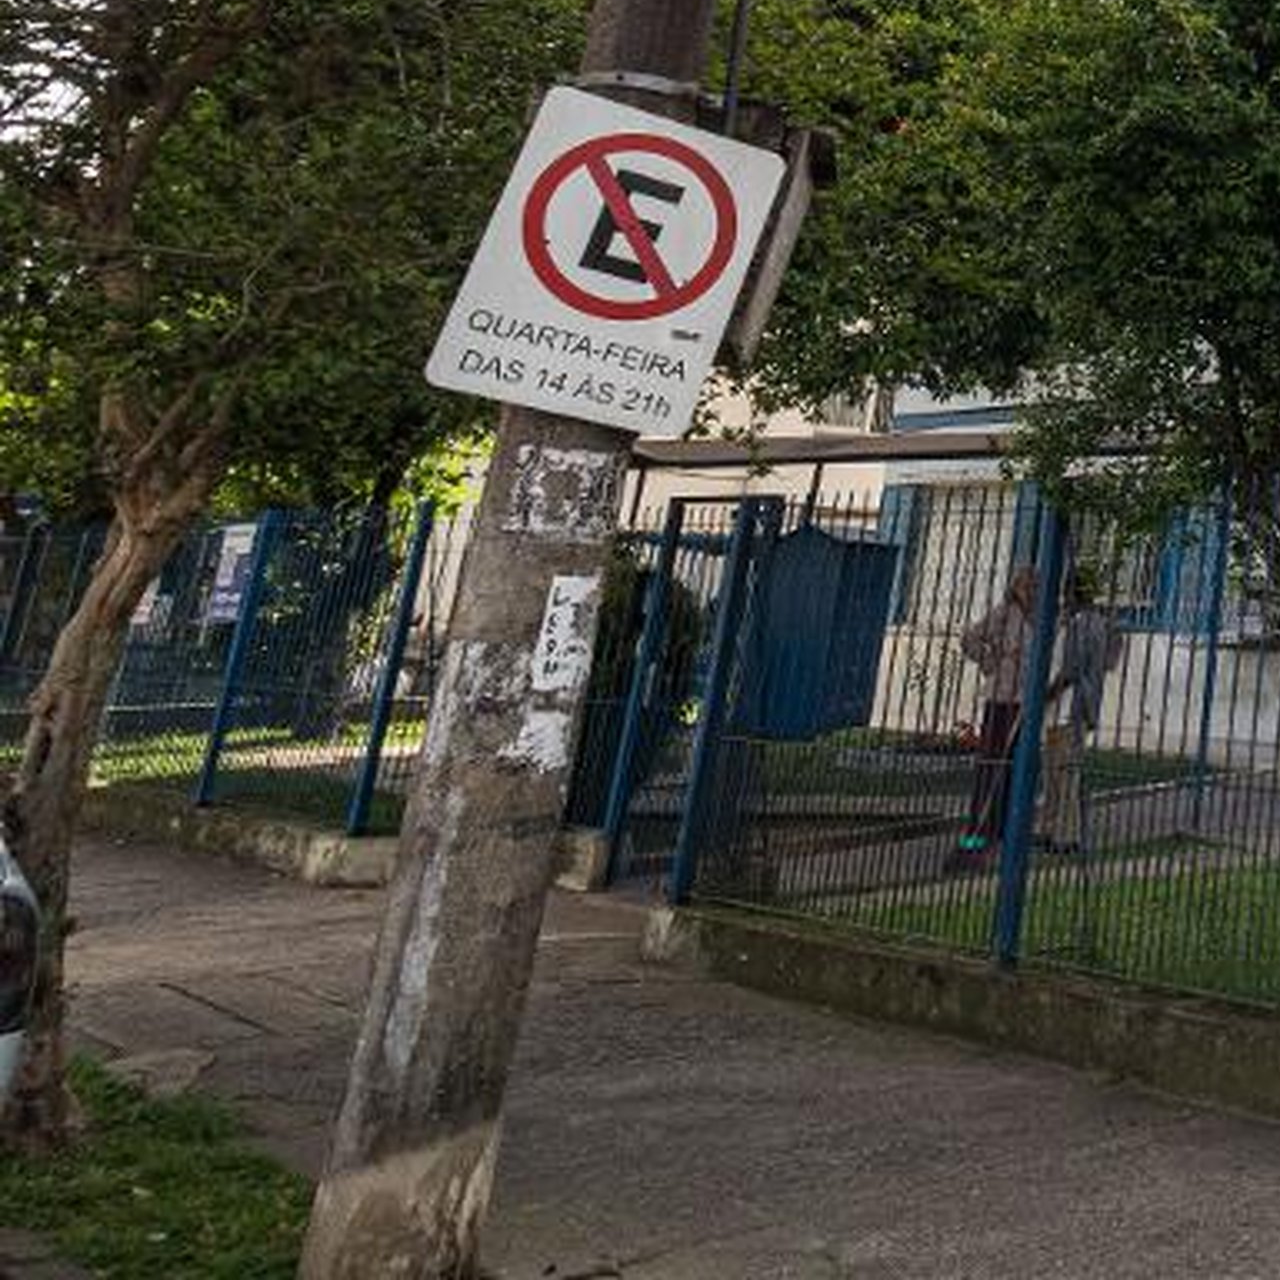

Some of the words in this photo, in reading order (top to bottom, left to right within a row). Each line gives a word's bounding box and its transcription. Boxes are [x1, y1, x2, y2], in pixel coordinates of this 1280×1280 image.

[579, 168, 685, 284] E
[468, 308, 686, 382] QUARTA-FEIRA
[459, 348, 525, 383] DAS
[536, 368, 566, 393] 14
[621, 389, 671, 419] 21h
